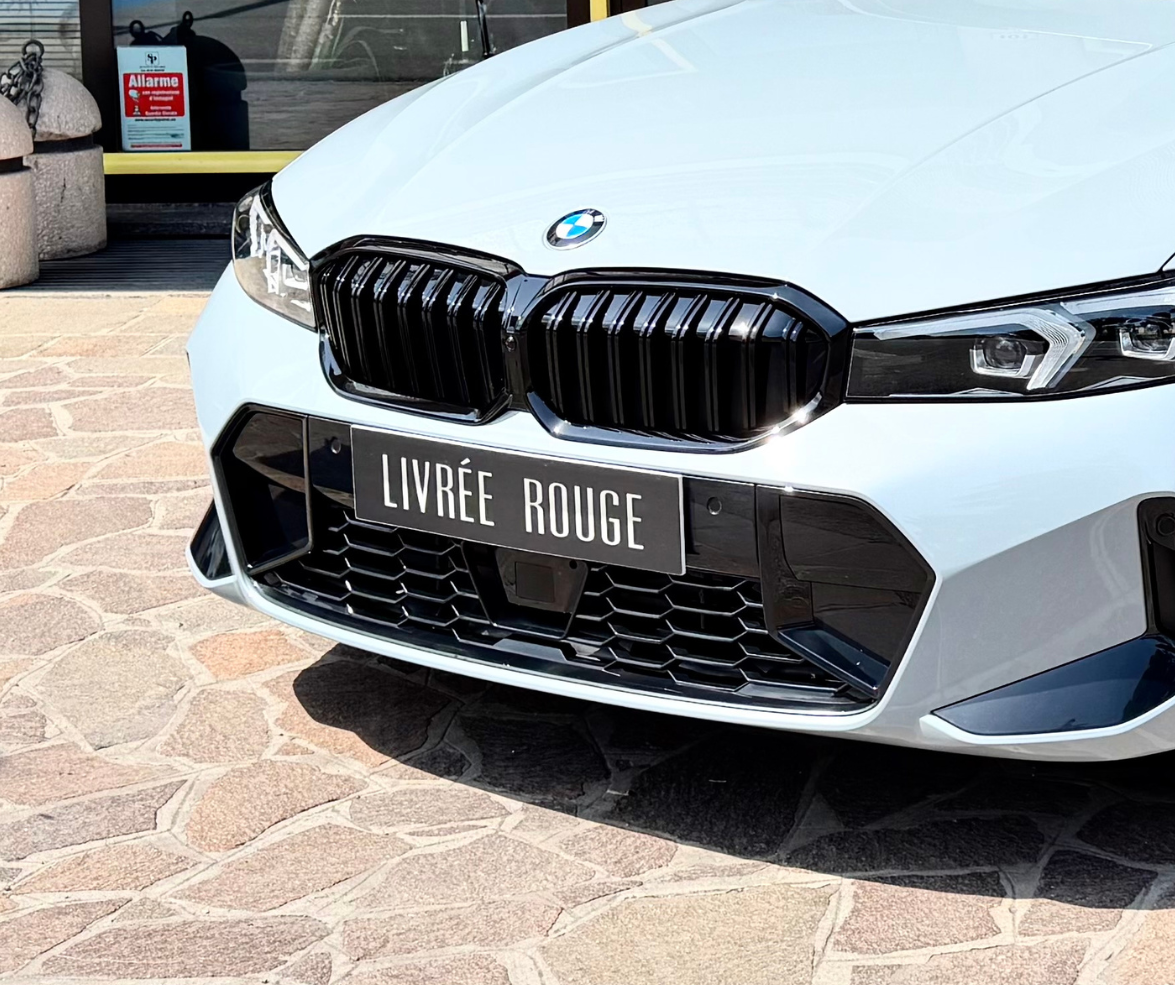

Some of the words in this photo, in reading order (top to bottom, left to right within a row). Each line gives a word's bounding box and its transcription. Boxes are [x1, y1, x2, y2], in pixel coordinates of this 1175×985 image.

[128, 74, 179, 88] Allarme
[381, 453, 495, 527] LIVRÉE
[523, 477, 645, 550] ROUGE
